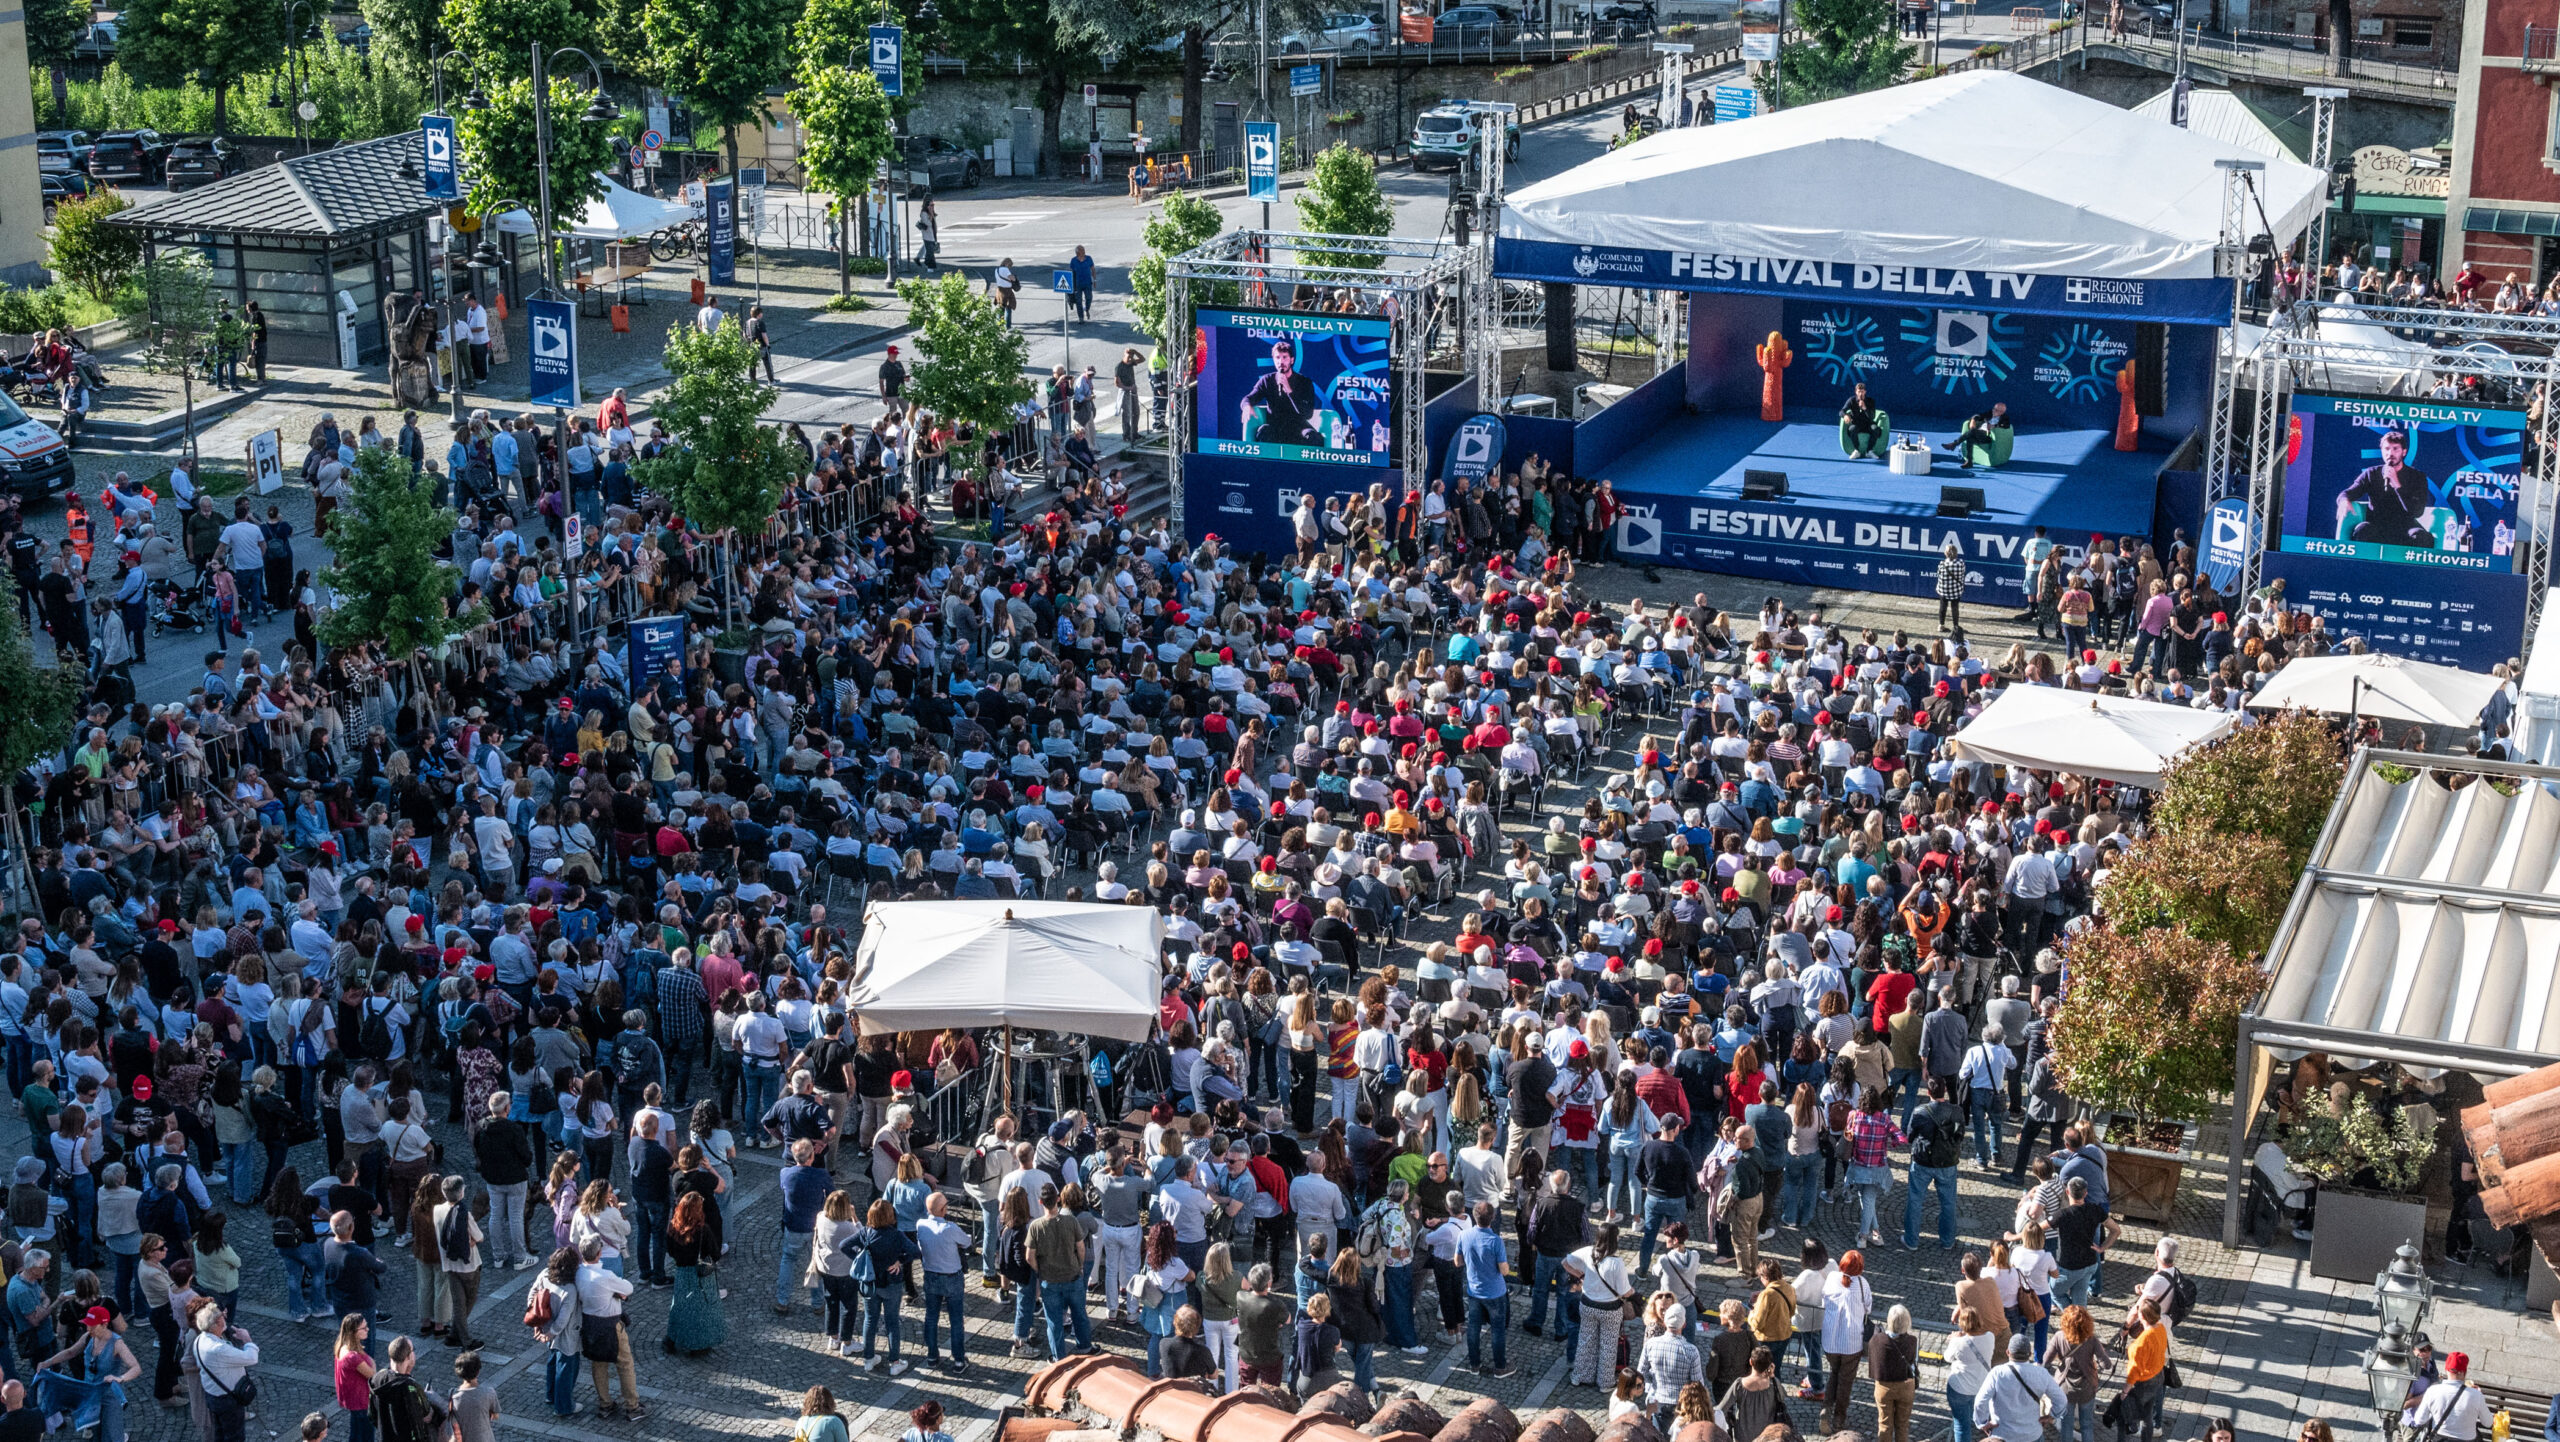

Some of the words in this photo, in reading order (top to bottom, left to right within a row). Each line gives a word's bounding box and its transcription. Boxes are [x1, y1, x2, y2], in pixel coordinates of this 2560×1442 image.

[1599, 253, 1633, 262] COMUNE
[1634, 254, 1643, 262] DI
[1599, 263, 1643, 273] DOGLIANI
[1671, 251, 1842, 288] FESTIVAL
[1853, 264, 1974, 297] DELLA
[1985, 272, 2036, 300] TV
[2092, 280, 2144, 295] REGIONE
[2091, 292, 2143, 306] PIEMONTE
[1231, 315, 1289, 328] FESTIVAL
[1292, 319, 1333, 331] DELLA
[1336, 322, 1353, 332] TV
[1801, 319, 1837, 329] FESTIVAL
[1247, 327, 1285, 339] DELLA
[1288, 330, 1303, 340] TV
[1801, 326, 1824, 335] DELLA
[2090, 347, 2115, 355] DELLA
[2091, 340, 2128, 350] FESTIVAL
[535, 357, 568, 368] FESTIVAL
[1854, 354, 1889, 363] FESTIVAL
[1935, 357, 1986, 369] FESTIVAL
[535, 365, 557, 374] DELLA
[559, 367, 568, 375] TV
[1854, 361, 1877, 369] DELLA
[1879, 362, 1889, 370] TV
[1934, 367, 1969, 378] DELLA
[1972, 370, 1986, 379] TV
[2034, 367, 2071, 377] FESTIVAL
[2034, 374, 2058, 382] DELLA
[1336, 375, 1390, 390] FESTIVA
[1337, 390, 1377, 402] DELLA
[2334, 401, 2404, 417] FESTIVAL
[2409, 406, 2457, 421] DELLA
[2462, 410, 2482, 423] TV
[2352, 415, 2398, 429] DELLA
[2403, 419, 2421, 430] TV
[1218, 443, 1260, 455] #ftv25
[1301, 449, 1371, 464] #ritrovarsi
[260, 454, 278, 479] P1
[2456, 470, 2520, 487] FESTIVA
[2455, 486, 2504, 500] DELLA
[1218, 505, 1243, 513] FONDAZIONE
[1690, 507, 1845, 544] FESTIVAL
[1854, 522, 1964, 555] DELLA
[1973, 532, 2020, 559] TV
[2211, 547, 2242, 560] FESTIVAL
[2305, 541, 2356, 556] #ftv25
[2405, 550, 2490, 569] #ritrovarsi
[2210, 555, 2231, 566] DELLA
[2232, 560, 2242, 568] TV
[2360, 594, 2384, 606] coop
[2391, 599, 2432, 609] FERRERO
[2450, 602, 2475, 610] PULSEE
